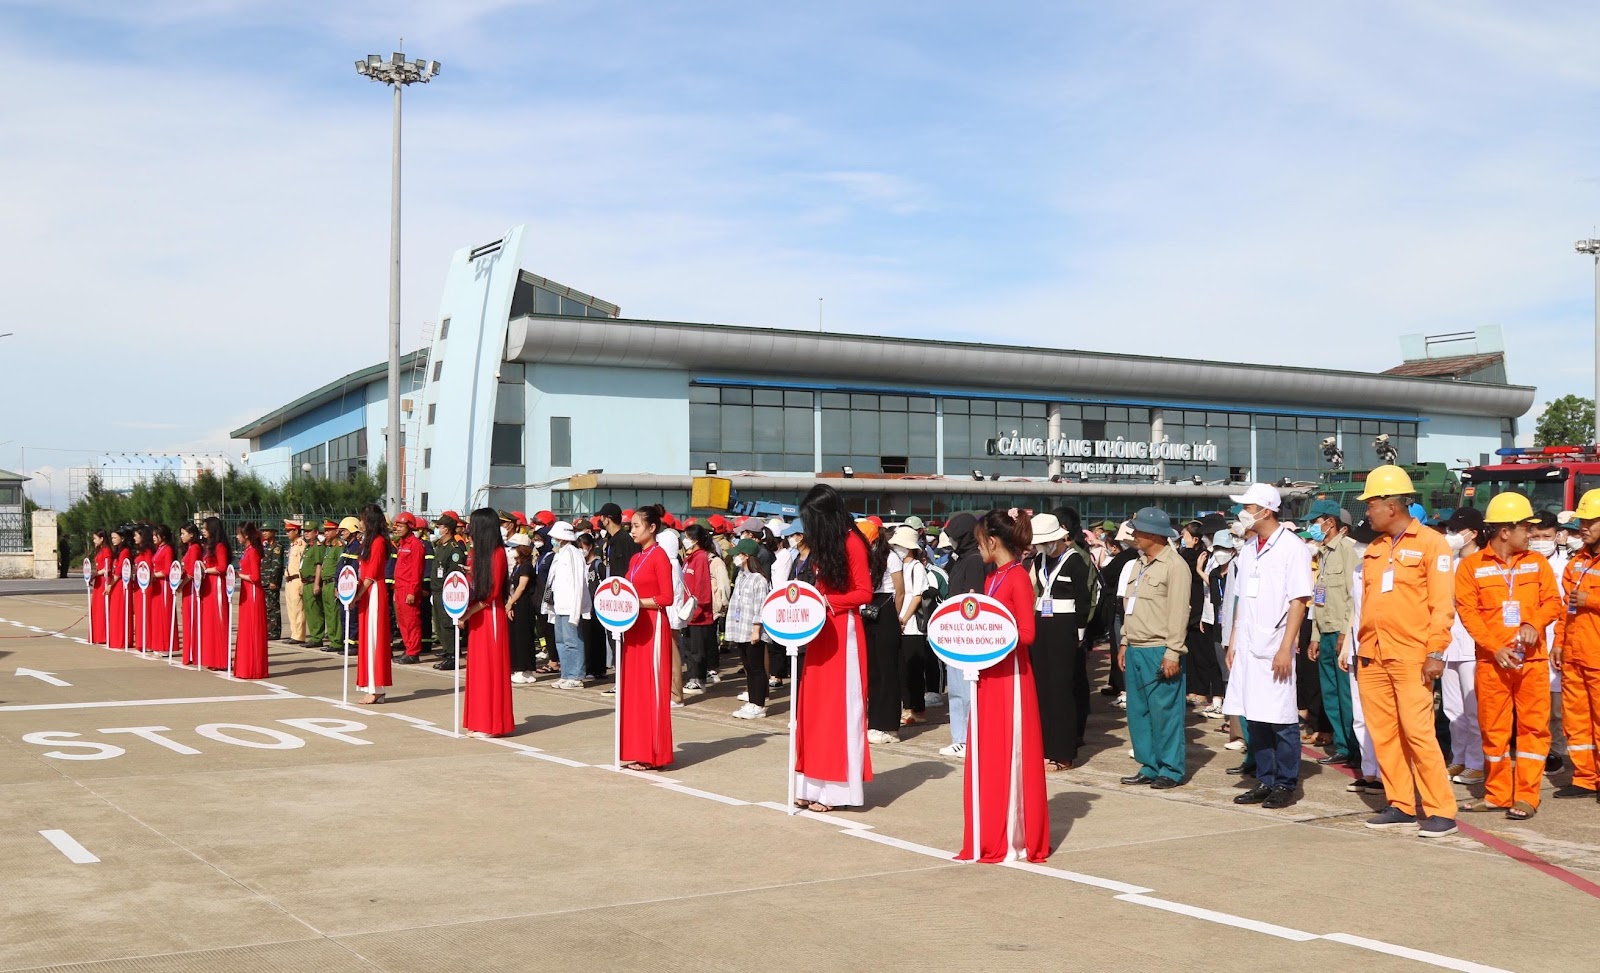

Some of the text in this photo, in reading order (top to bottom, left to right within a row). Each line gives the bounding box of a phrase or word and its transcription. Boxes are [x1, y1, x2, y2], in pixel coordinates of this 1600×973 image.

[999, 430, 1044, 456] CẢNG
[1047, 432, 1092, 457] HÀNG
[1095, 436, 1148, 459] KHÔNG
[1193, 440, 1217, 461] HỚI
[1115, 464, 1159, 476] AIRPORT
[22, 717, 375, 760] STOP
